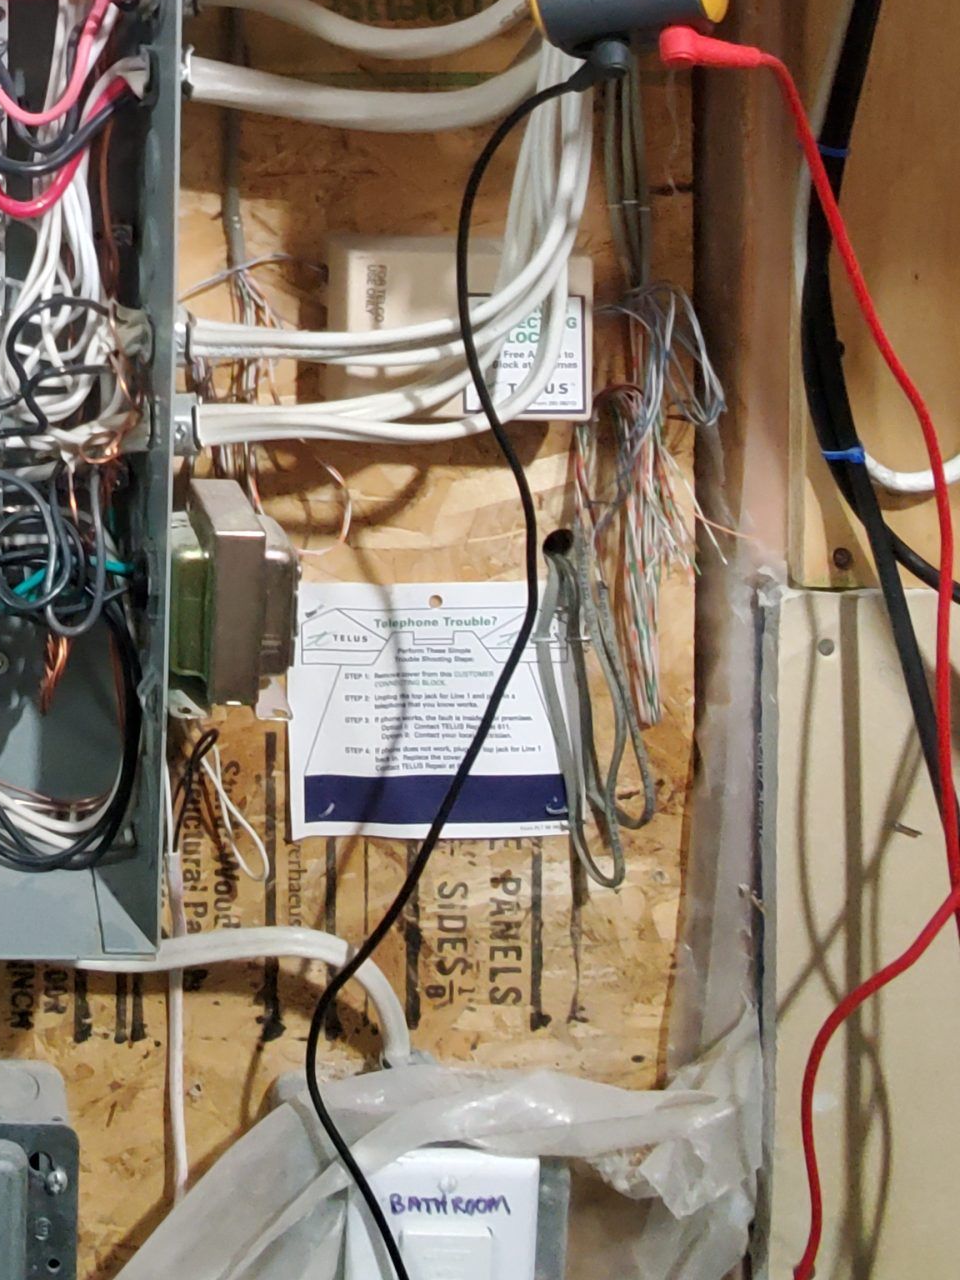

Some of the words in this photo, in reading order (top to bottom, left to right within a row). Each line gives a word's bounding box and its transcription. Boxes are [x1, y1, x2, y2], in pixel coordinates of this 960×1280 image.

[504, 350, 525, 358] Free
[507, 383, 569, 394] TUS
[374, 616, 439, 629] Telephone
[443, 616, 497, 627] Trouble?
[333, 634, 368, 643] TELUS
[489, 876, 522, 1006] PANELS
[390, 1193, 512, 1216] BATHROOM
